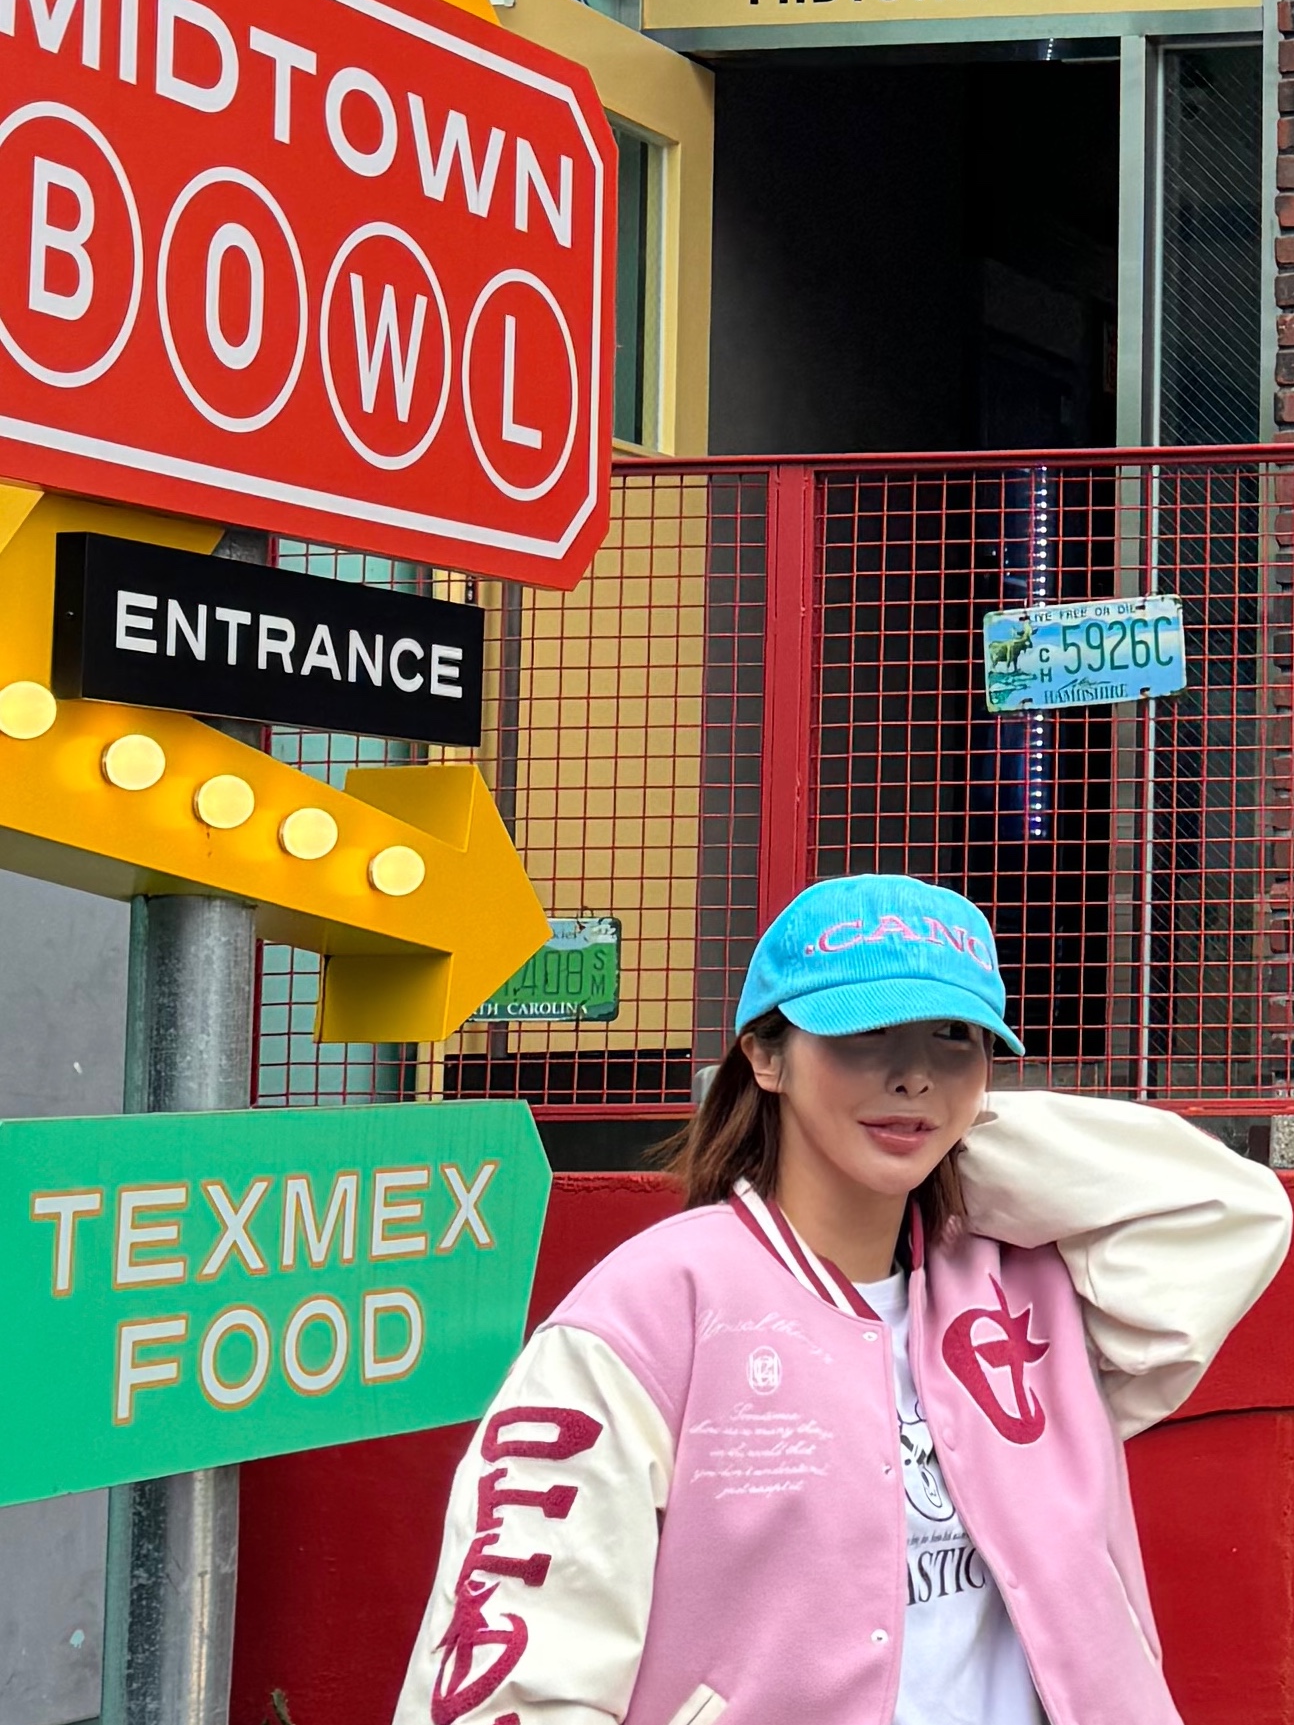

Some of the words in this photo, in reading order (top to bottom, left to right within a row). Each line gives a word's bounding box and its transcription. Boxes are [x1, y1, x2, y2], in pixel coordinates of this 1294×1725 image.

[28, 156, 543, 450] BOWL
[115, 590, 464, 700] ENTRANCE
[1062, 616, 1174, 675] 5926C
[30, 1158, 499, 1298] TEXMEX
[113, 1286, 424, 1427] FOOD
